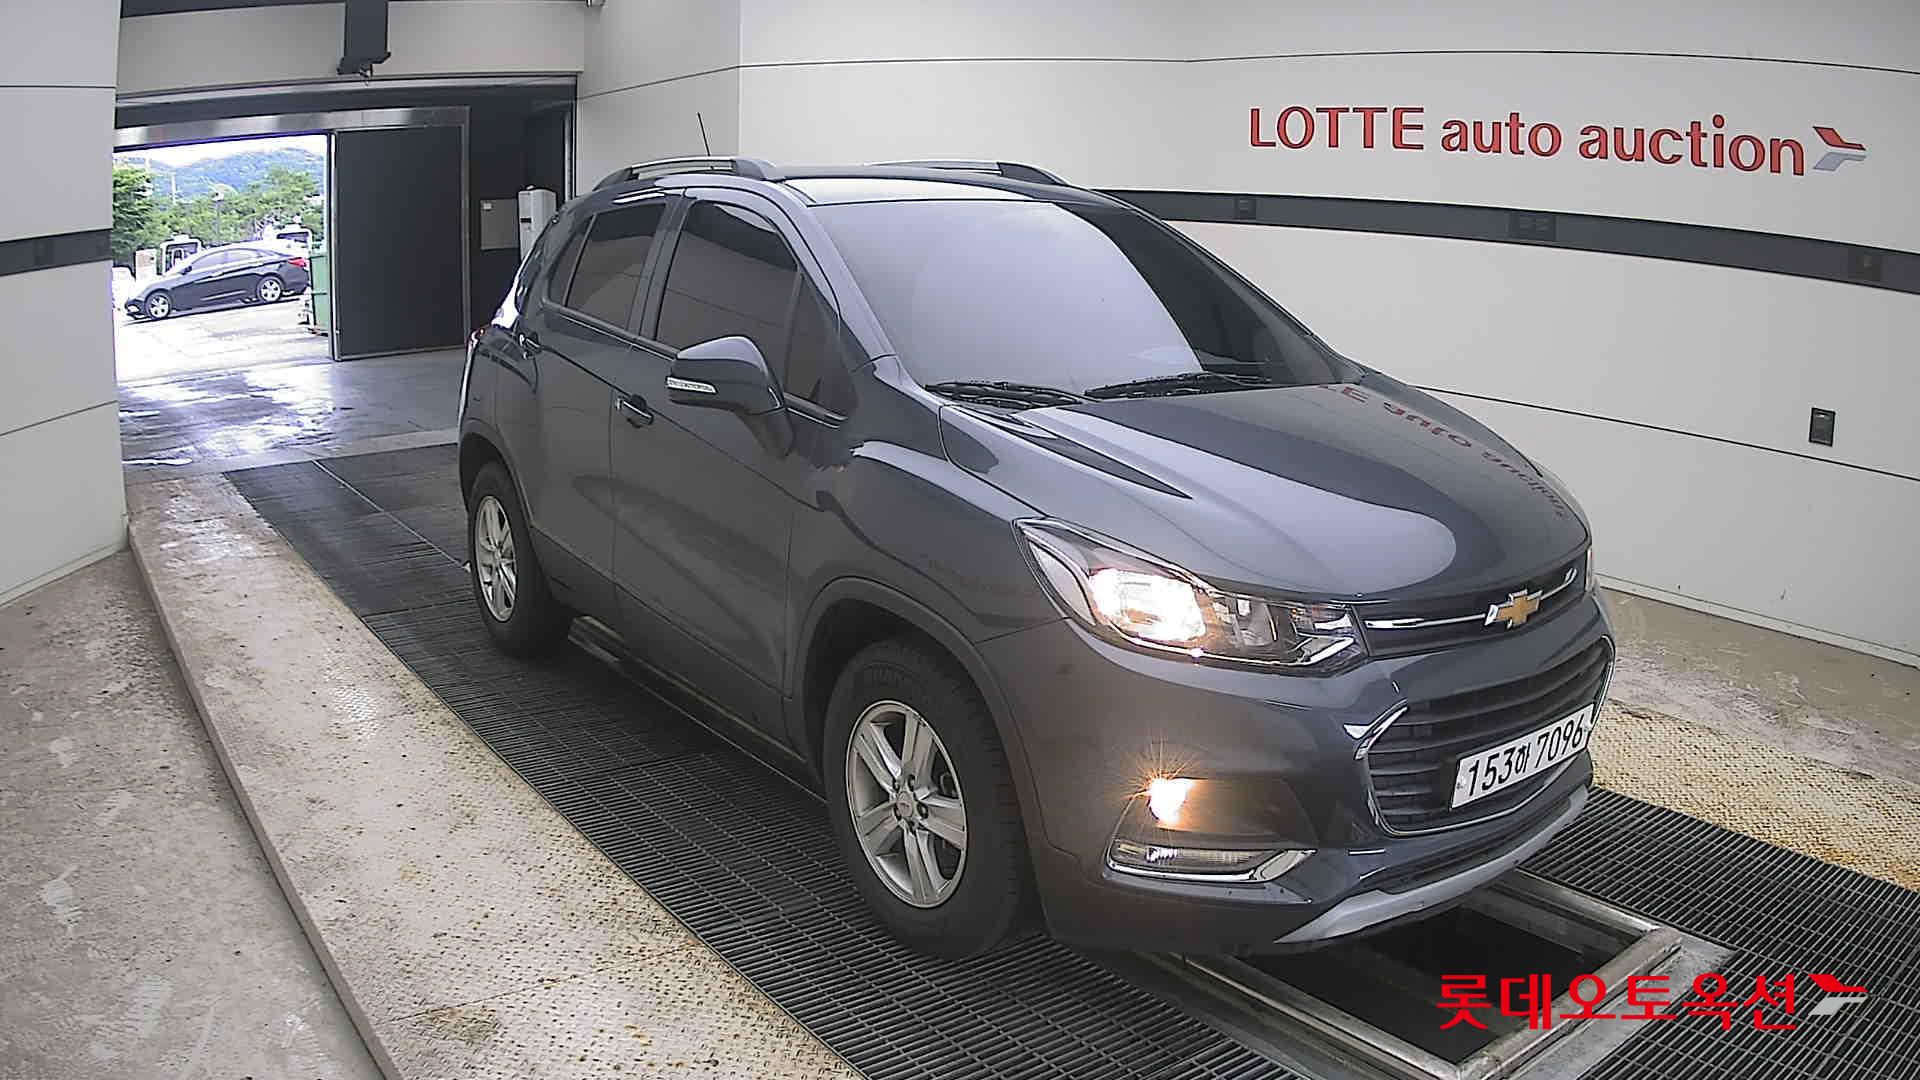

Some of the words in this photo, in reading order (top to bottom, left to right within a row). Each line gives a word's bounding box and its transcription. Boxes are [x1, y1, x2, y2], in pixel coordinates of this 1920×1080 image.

[1249, 105, 1425, 151] LOTTE
[1440, 111, 1563, 157] auto
[1578, 113, 1806, 177] auction
[1467, 742, 1532, 797] 153하
[1535, 713, 1585, 769] 7096
